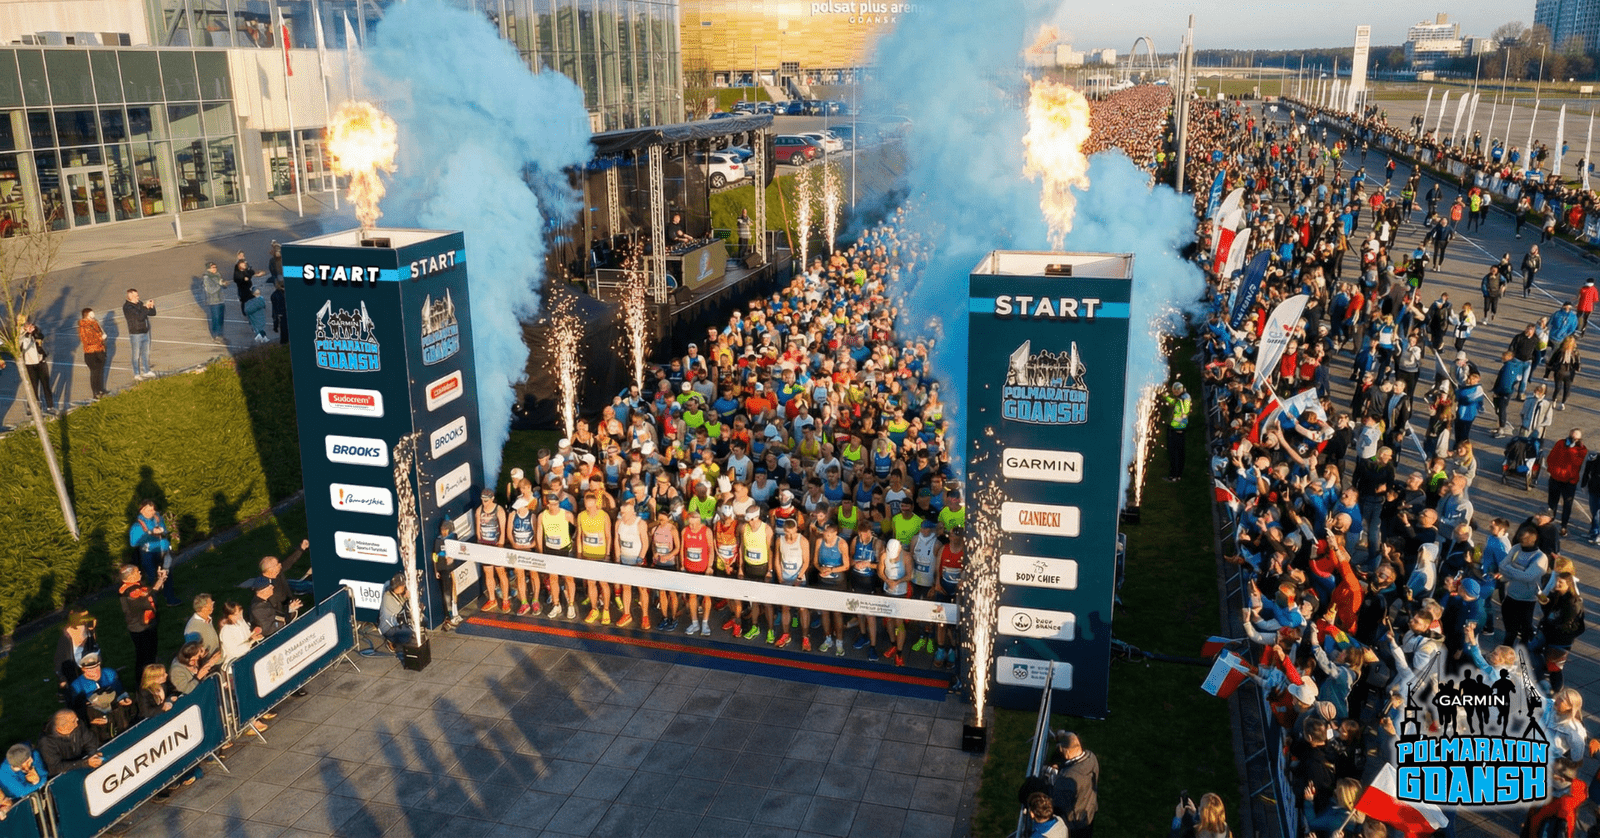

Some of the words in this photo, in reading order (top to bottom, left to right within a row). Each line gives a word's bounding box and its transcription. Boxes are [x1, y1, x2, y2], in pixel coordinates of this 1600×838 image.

[811, 0, 855, 15] polsat
[860, 0, 887, 15] plus
[303, 264, 379, 282] START
[410, 250, 456, 278] START
[995, 295, 1100, 318] START
[435, 425, 464, 450] BROOKS
[332, 444, 380, 457] BROOKS
[1006, 458, 1075, 472] GARMIN
[1019, 510, 1061, 528] CZANIECKI
[1016, 572, 1036, 582] BODY
[1037, 574, 1061, 584] CHIEF
[360, 586, 380, 599] labo
[102, 724, 190, 794] GARMIN
